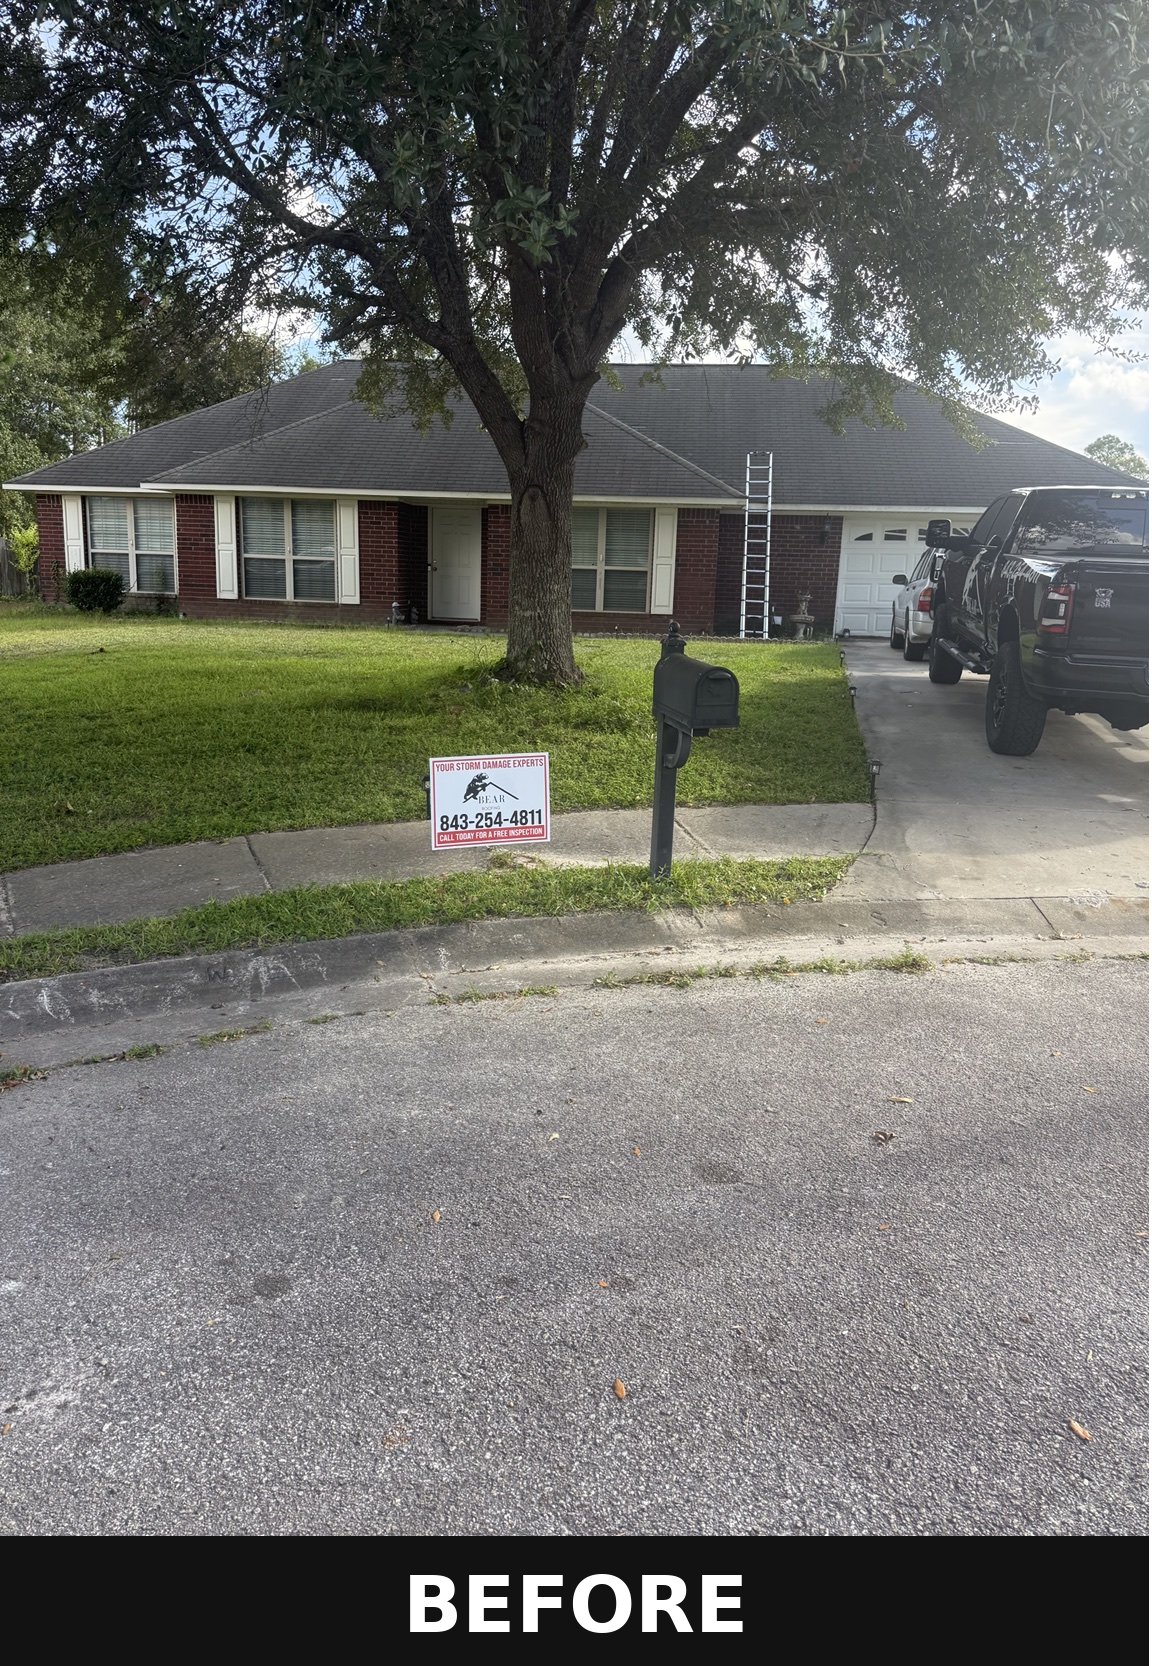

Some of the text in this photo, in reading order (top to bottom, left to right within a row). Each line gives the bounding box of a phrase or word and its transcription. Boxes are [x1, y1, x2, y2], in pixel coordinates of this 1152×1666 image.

[435, 758, 544, 772] YOUR STORM DAMAGE EXPERTS
[478, 795, 505, 804] BEAR
[440, 809, 542, 831] 843-254-4811
[439, 827, 543, 842] CALL TODAY FOR A FREE INSPECTION
